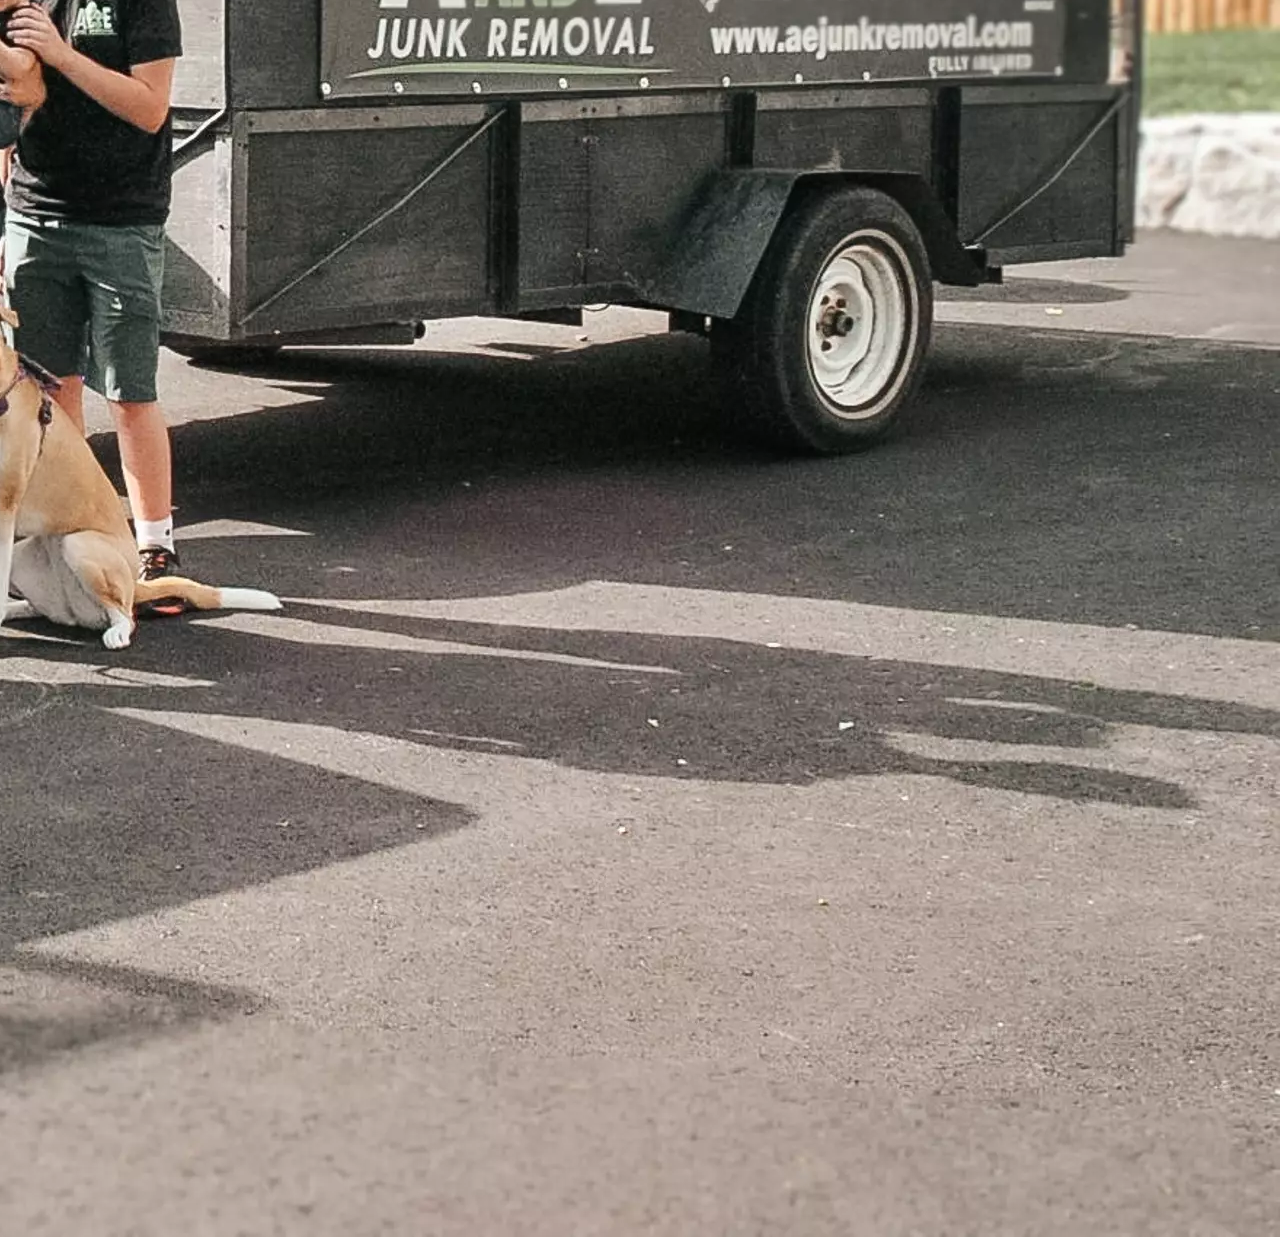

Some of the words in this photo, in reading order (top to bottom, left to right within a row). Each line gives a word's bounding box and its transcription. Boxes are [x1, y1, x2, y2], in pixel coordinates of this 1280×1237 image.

[367, 17, 472, 58] JUNK
[487, 16, 655, 58] REMOVAL
[710, 14, 1033, 60] www.aejunkremoval.com
